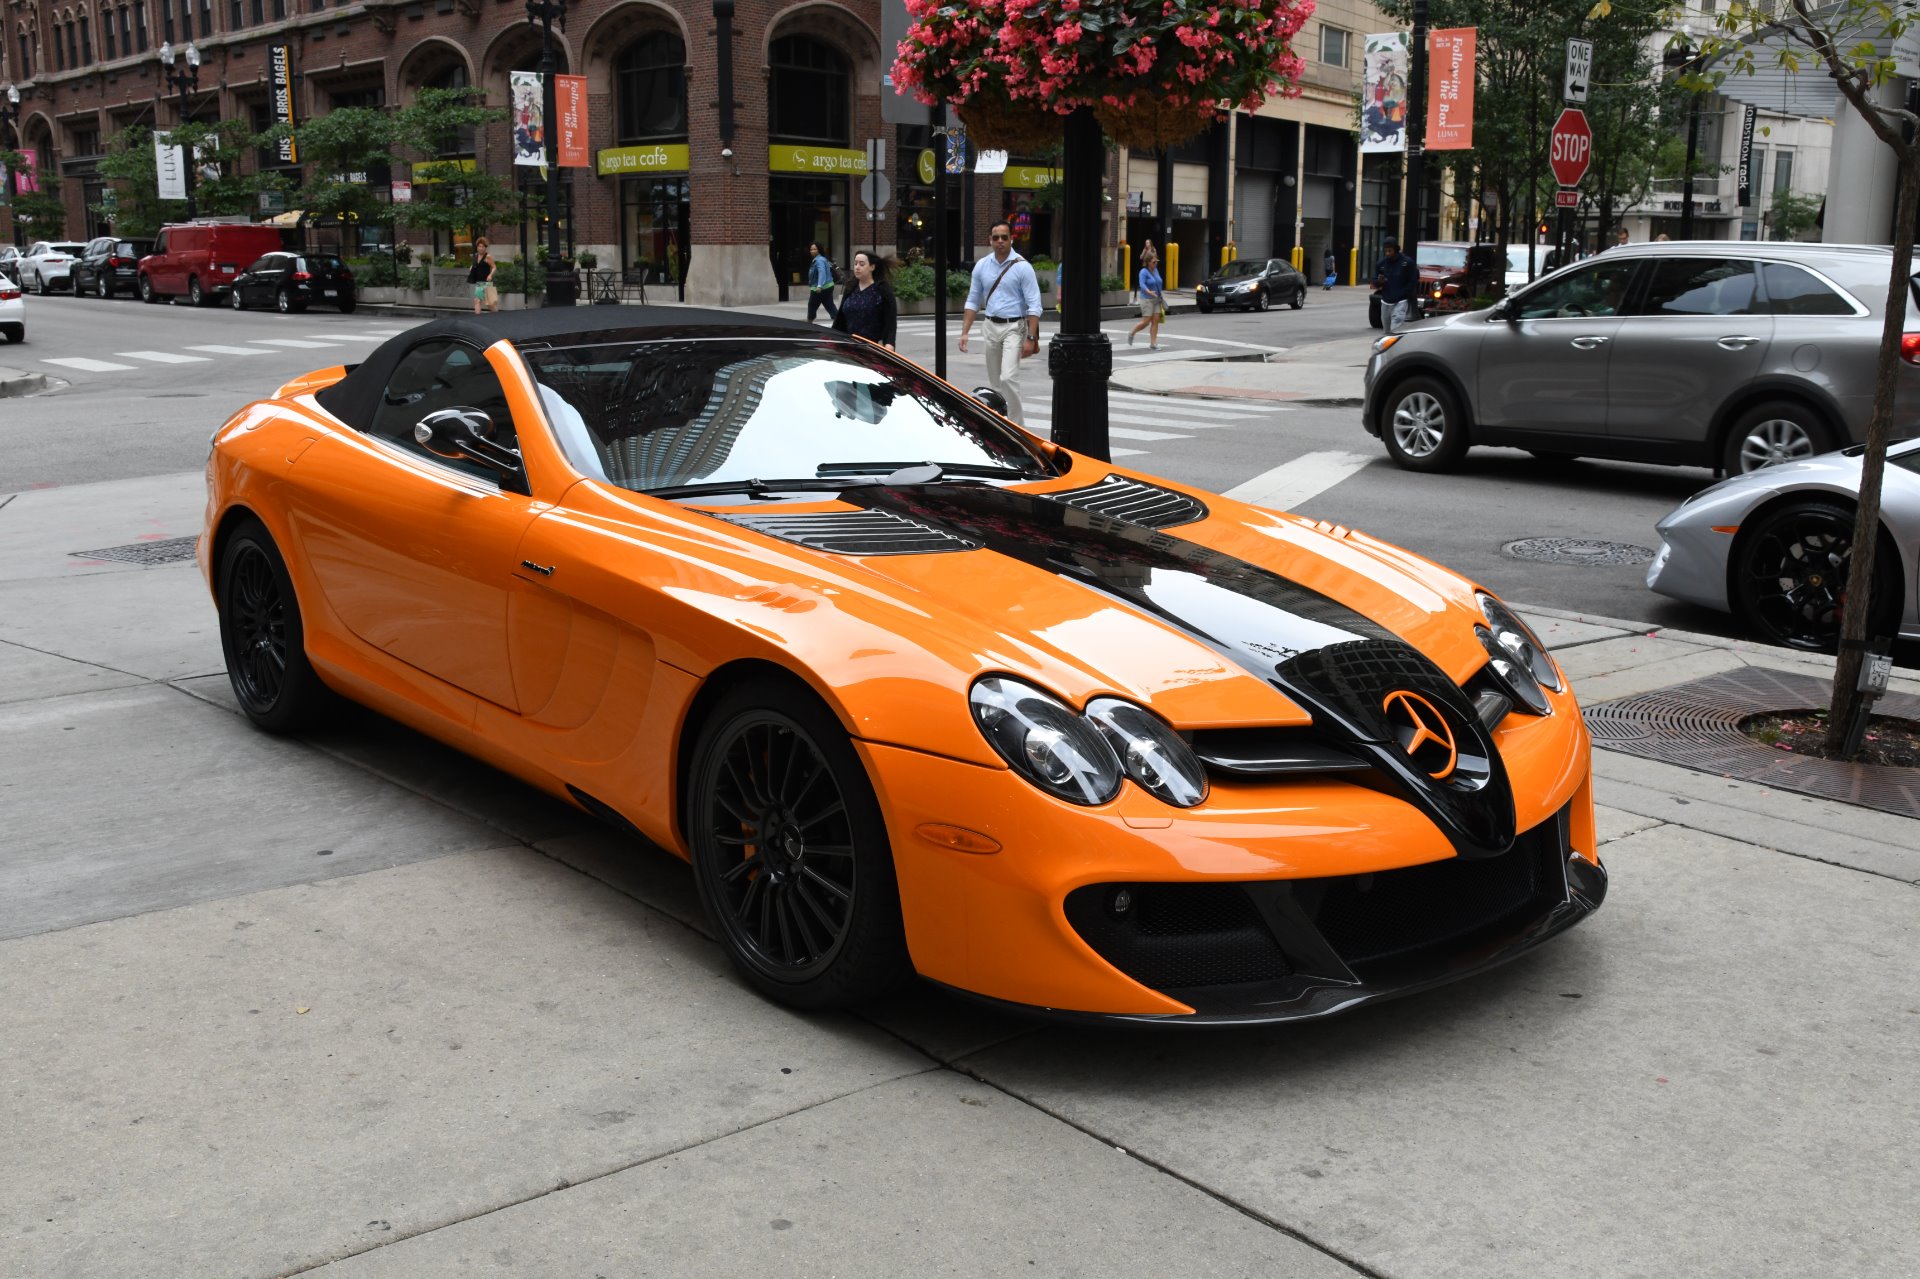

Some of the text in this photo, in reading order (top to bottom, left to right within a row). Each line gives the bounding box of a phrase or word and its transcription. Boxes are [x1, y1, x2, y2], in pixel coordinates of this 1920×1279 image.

[1571, 44, 1589, 62] ONE
[273, 46, 286, 85] BAGELS
[1449, 37, 1463, 100] Following
[1569, 62, 1588, 78] WAY
[276, 87, 289, 114] BROS.
[1440, 80, 1450, 100] the
[1439, 103, 1450, 127] Box
[565, 131, 573, 148] Box
[1437, 129, 1458, 138] LUMA
[623, 153, 636, 167] tea
[639, 146, 668, 166] café
[1553, 132, 1589, 162] STOP
[163, 148, 177, 181] LUM
[812, 155, 837, 171] argo
[839, 154, 851, 169] tea
[1739, 164, 1749, 189] rack
[1557, 194, 1576, 205] ALL WAY
